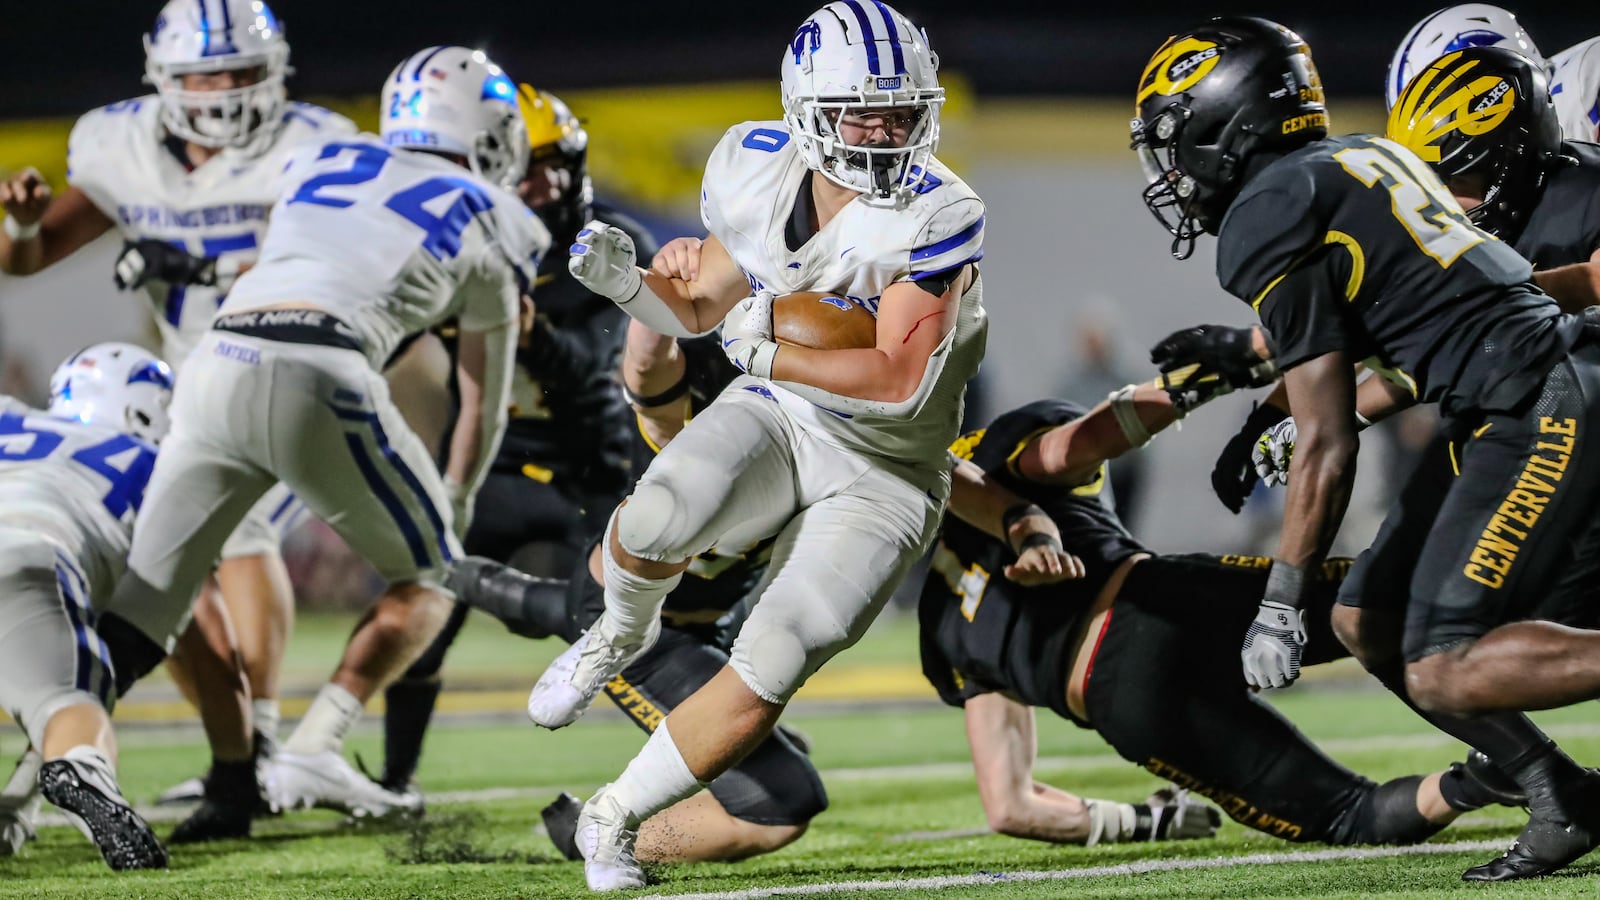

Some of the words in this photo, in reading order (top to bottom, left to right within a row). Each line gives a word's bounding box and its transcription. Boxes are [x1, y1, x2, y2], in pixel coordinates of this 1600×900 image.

[1171, 47, 1218, 78] ELKS
[878, 78, 900, 90] BORO
[1474, 80, 1510, 115] ELKS
[741, 127, 791, 153] 0
[286, 141, 495, 263] 24
[259, 309, 328, 327] NIKE
[0, 409, 158, 521] 54
[1464, 416, 1577, 589] CENTERVILLE
